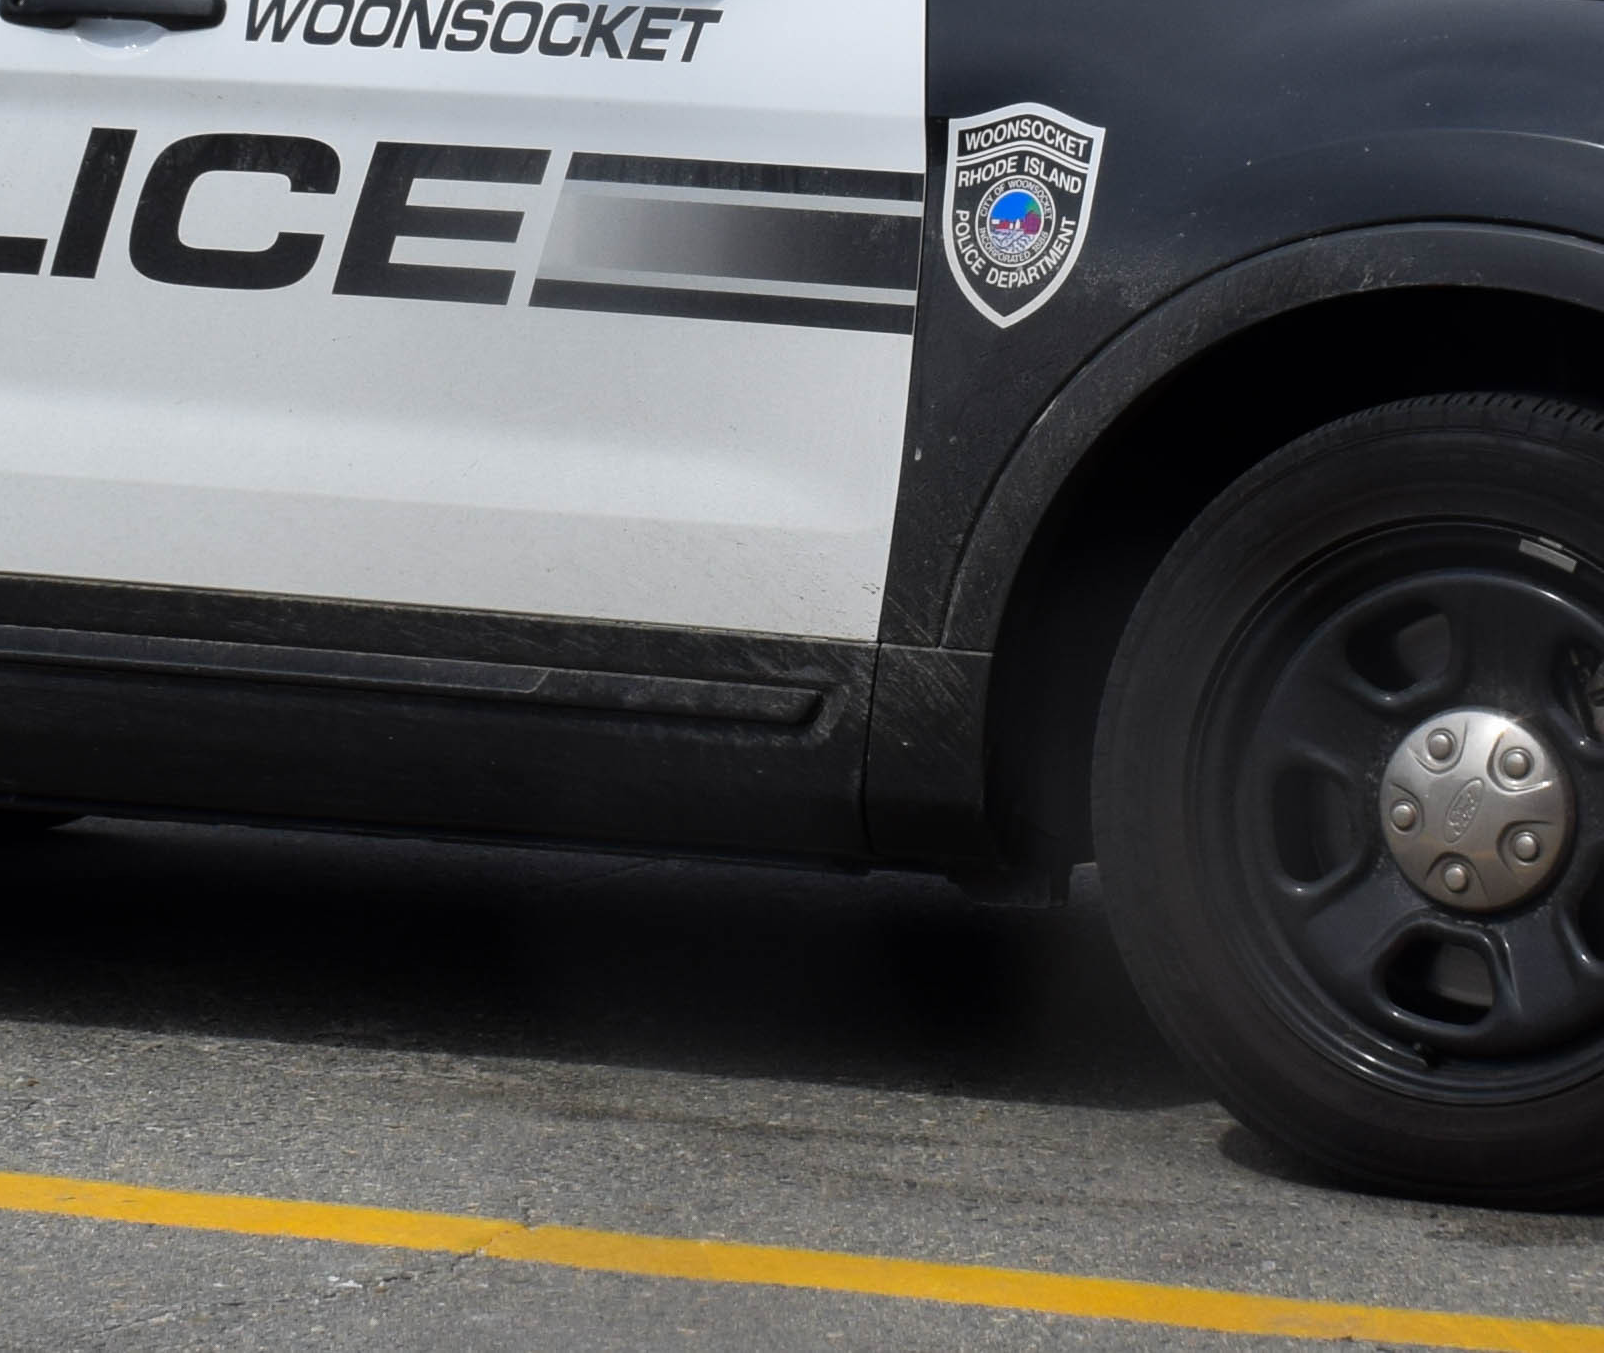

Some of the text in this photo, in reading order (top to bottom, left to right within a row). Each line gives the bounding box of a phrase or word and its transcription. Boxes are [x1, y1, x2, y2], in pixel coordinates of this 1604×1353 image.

[966, 118, 1088, 158] WOONSOCKET
[958, 156, 1082, 194] RHODE ISLAND
[980, 196, 994, 217] CITY
[994, 183, 1005, 196] OF
[956, 209, 1076, 288] POLICE DEPARTMENT
